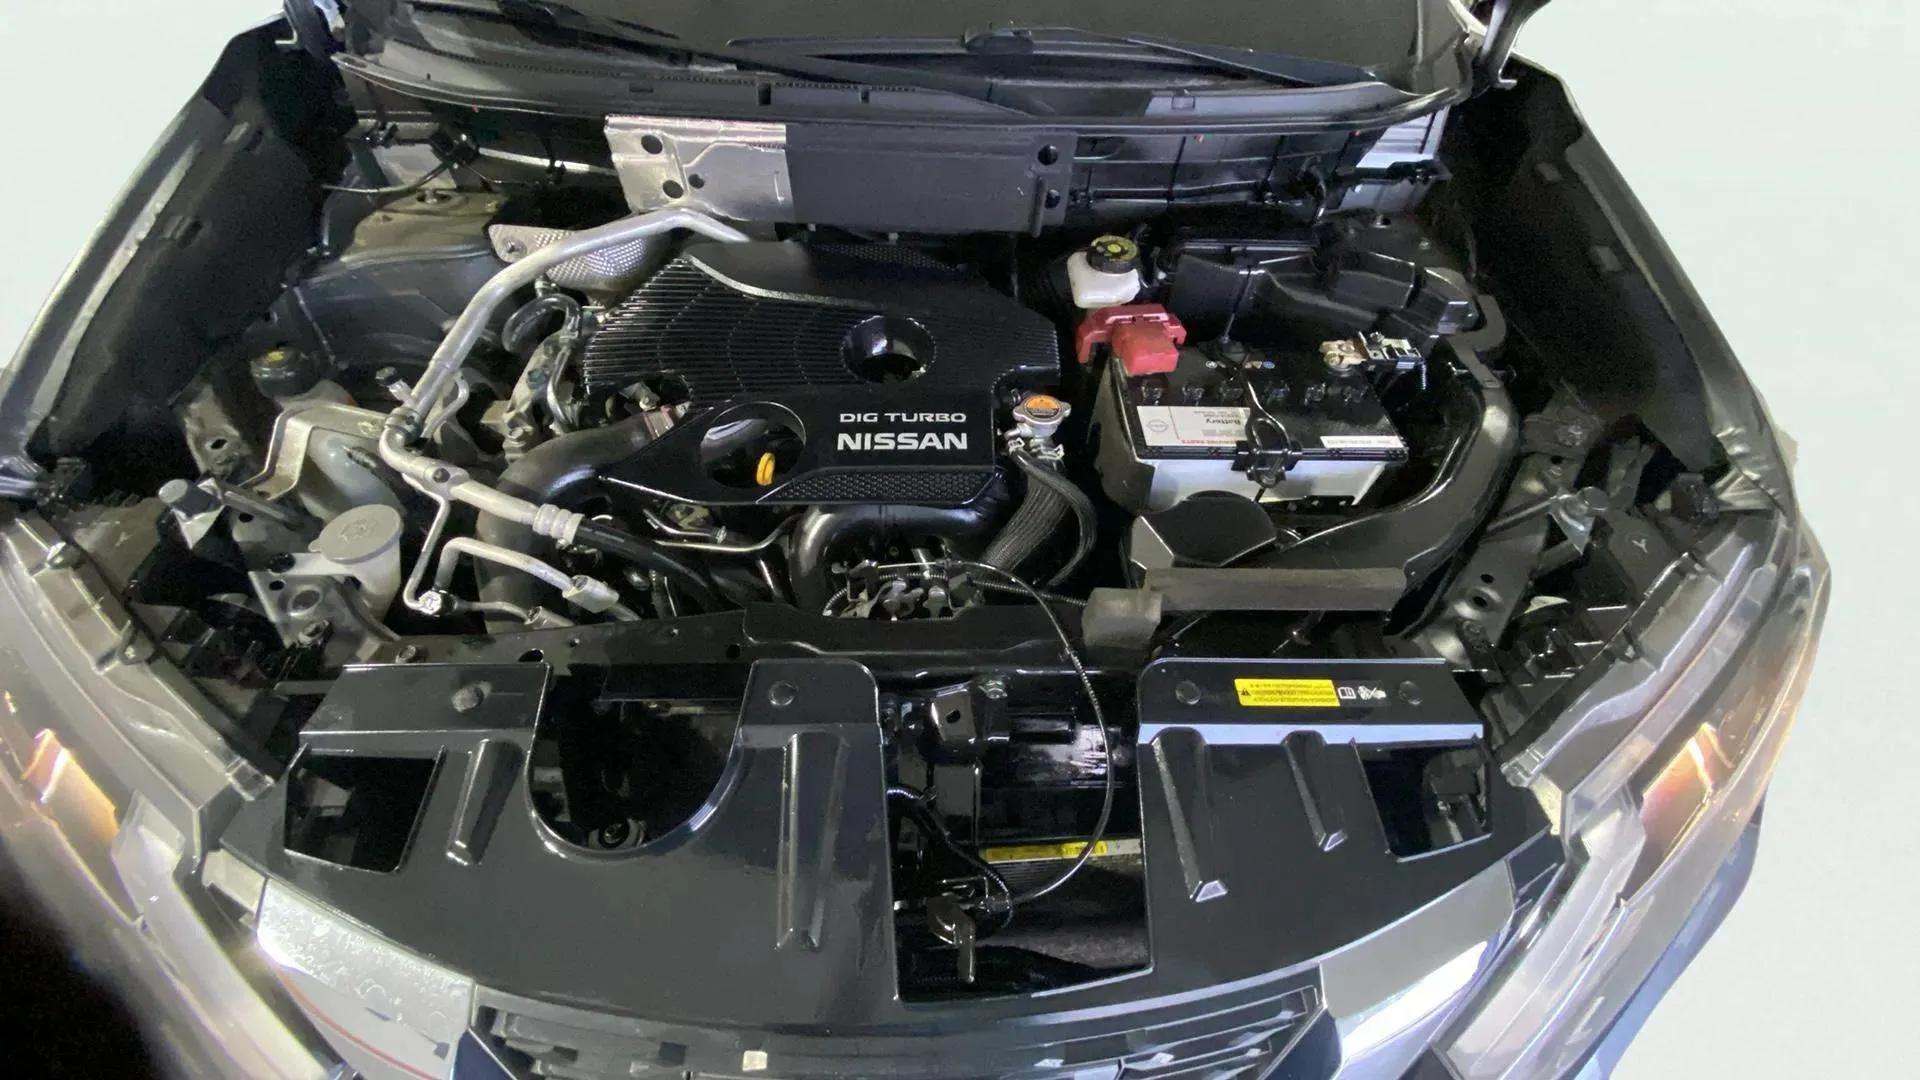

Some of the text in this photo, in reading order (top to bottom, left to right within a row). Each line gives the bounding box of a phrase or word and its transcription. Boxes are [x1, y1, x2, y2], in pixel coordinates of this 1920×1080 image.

[840, 412, 967, 423] DIG TURBO
[837, 432, 968, 451] NISSAN
